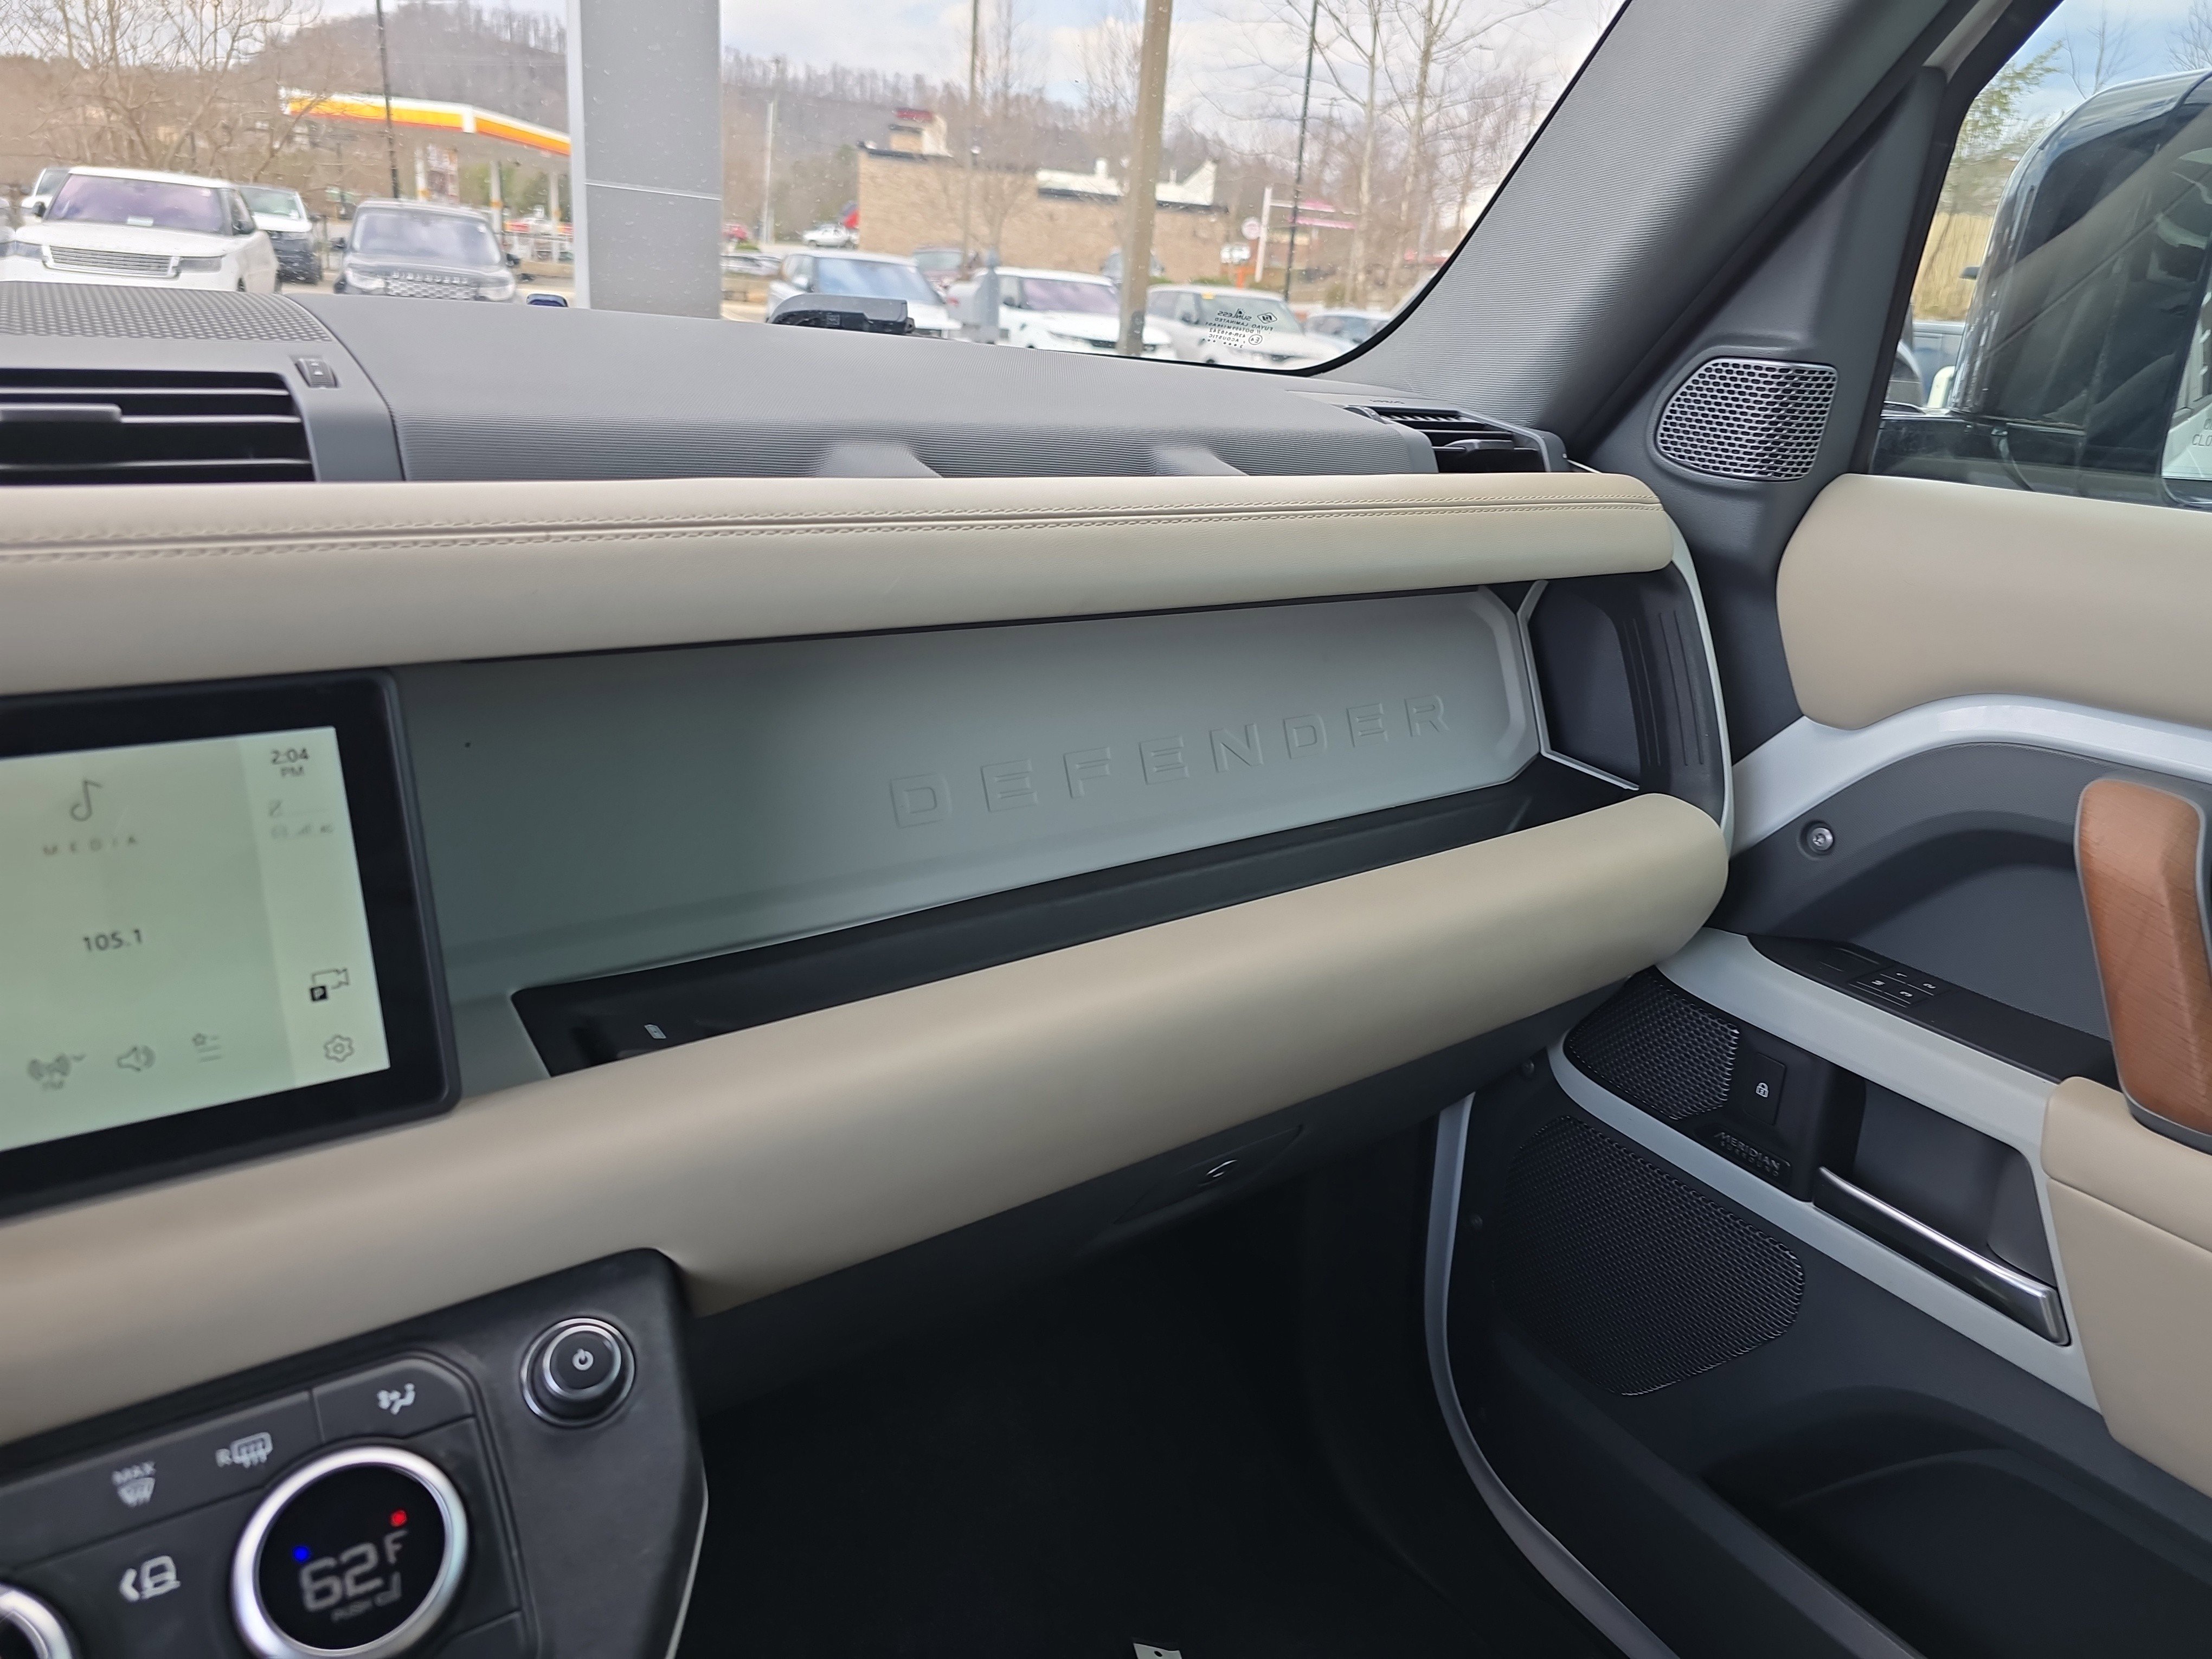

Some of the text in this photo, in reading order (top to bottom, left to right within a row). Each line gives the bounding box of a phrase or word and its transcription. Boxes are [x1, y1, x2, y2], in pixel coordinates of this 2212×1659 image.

[271, 747, 309, 765] 2:04
[890, 694, 1450, 829] DEFENDER
[83, 928, 142, 951] 105.1
[1713, 1132, 1780, 1171] MERIDIAN
[111, 1461, 156, 1486] MAX
[300, 1542, 384, 1612] 62
